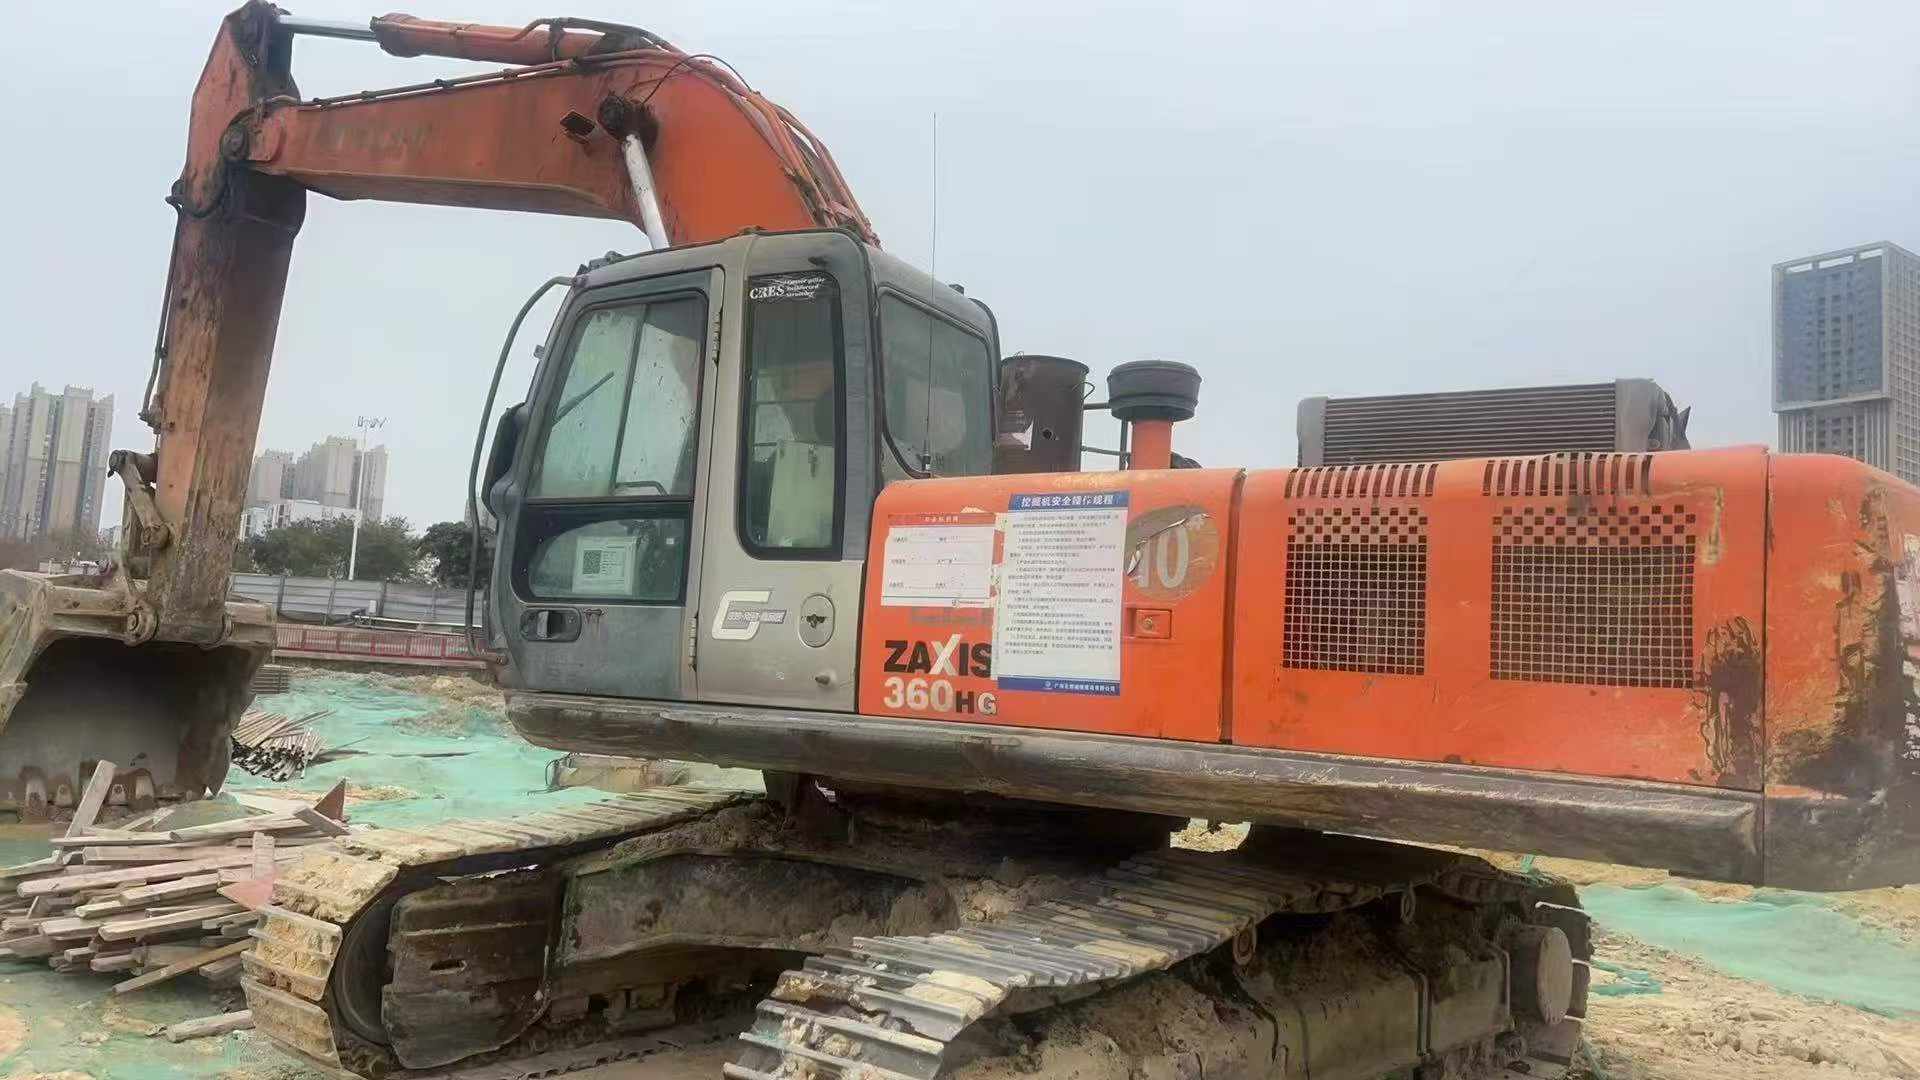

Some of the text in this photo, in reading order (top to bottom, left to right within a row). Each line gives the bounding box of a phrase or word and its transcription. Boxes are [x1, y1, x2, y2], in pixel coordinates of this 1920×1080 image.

[1021, 494, 1114, 508] 挖掘机安全操作规程
[884, 633, 992, 678] ZAXIS
